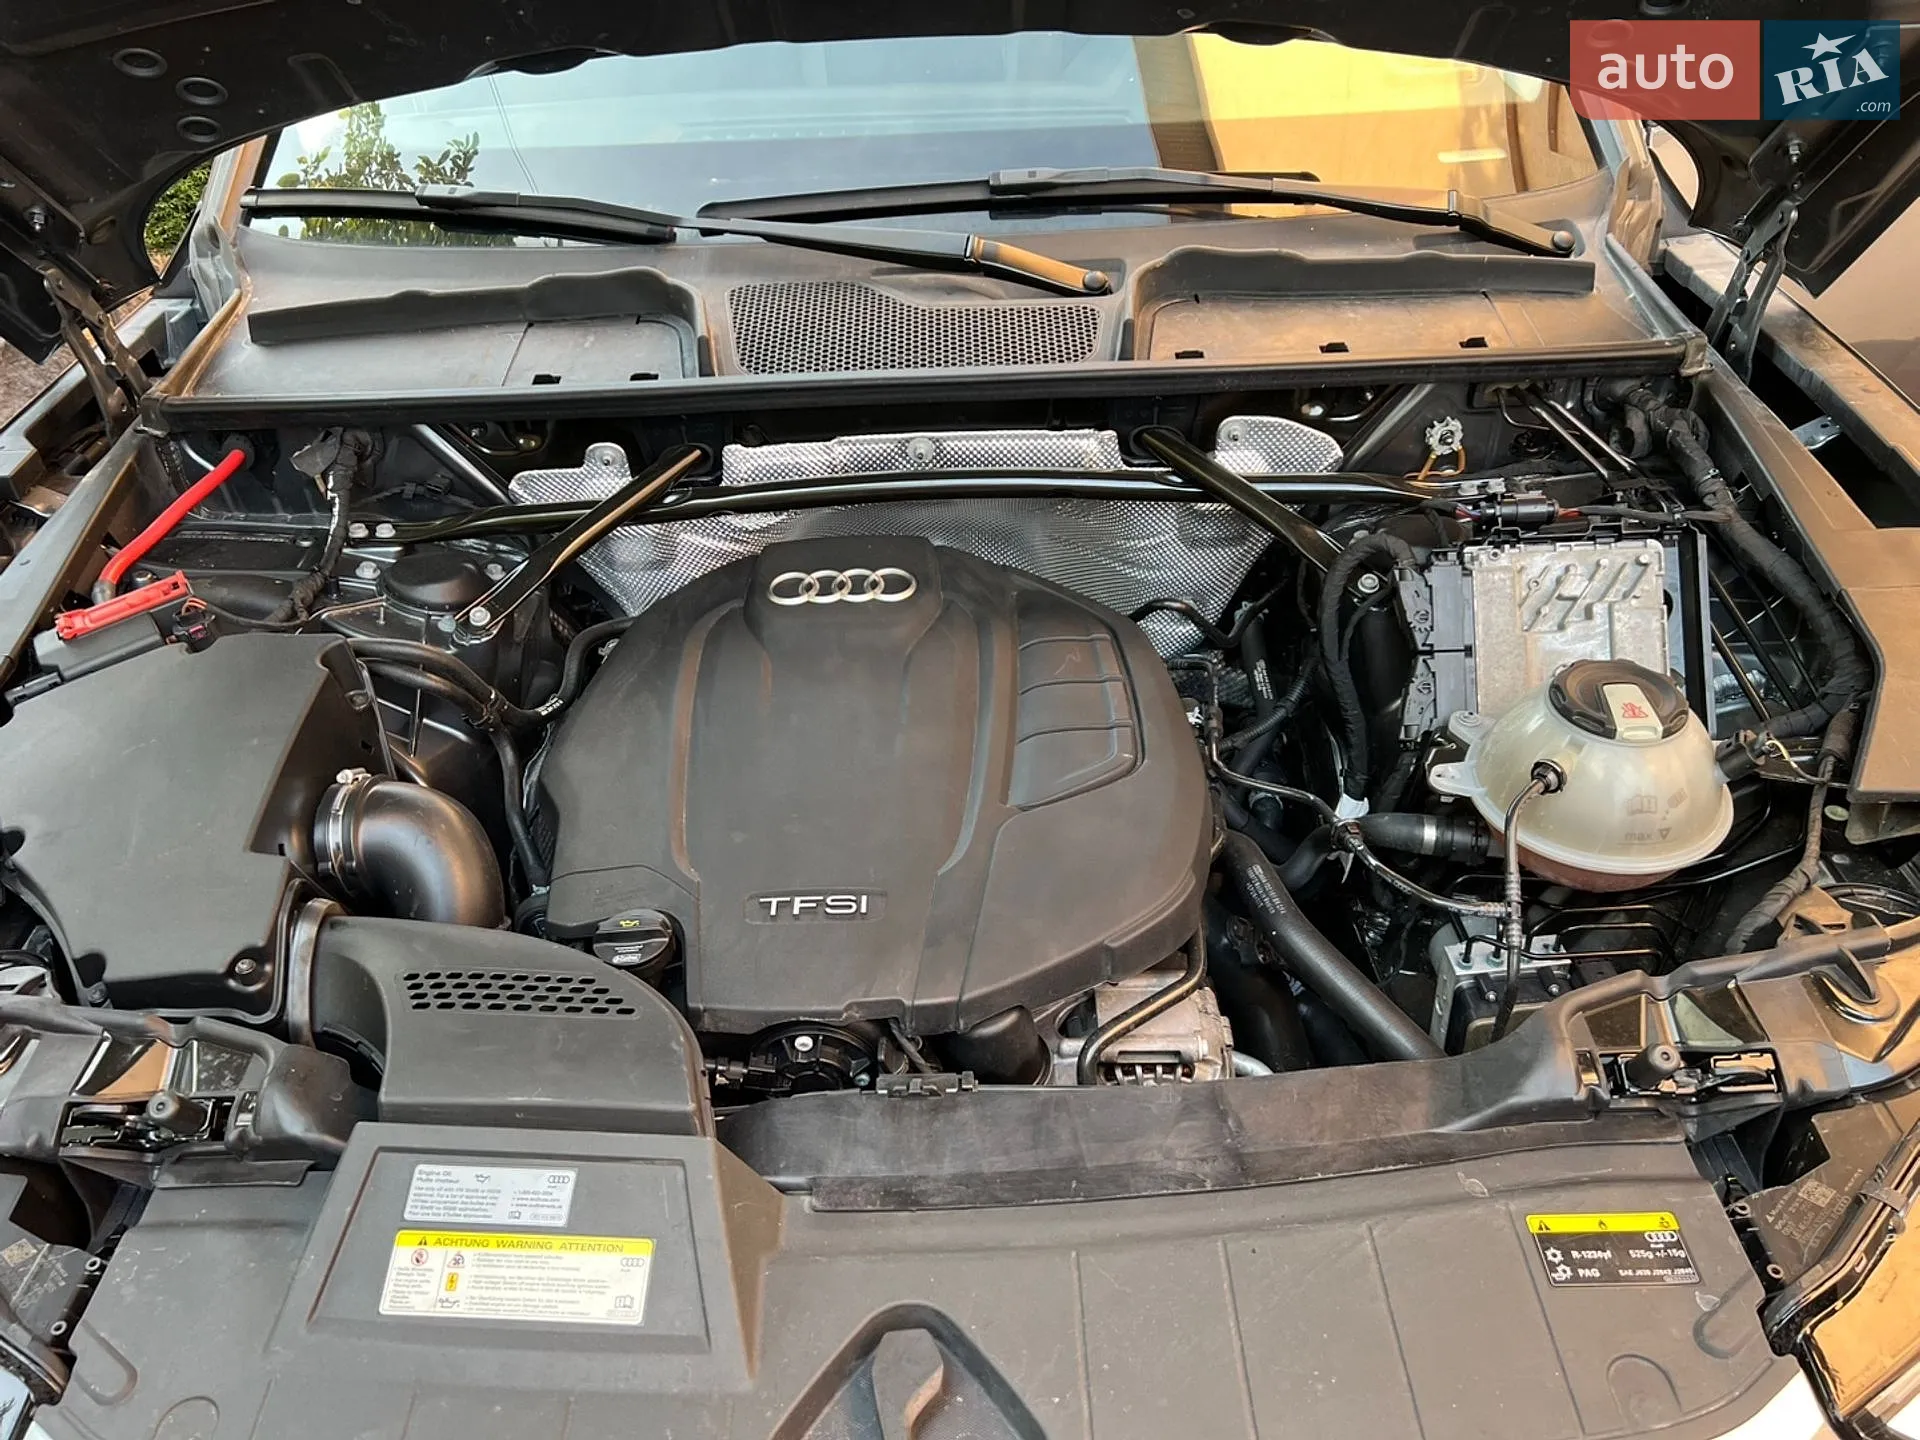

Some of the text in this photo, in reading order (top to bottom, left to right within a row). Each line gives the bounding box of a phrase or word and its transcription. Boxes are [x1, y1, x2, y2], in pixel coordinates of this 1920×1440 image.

[759, 895, 868, 916] TFSI
[434, 1236, 624, 1253] ACHTUNG WARNING ATTENTION
[1577, 1268, 1600, 1278] PAG
